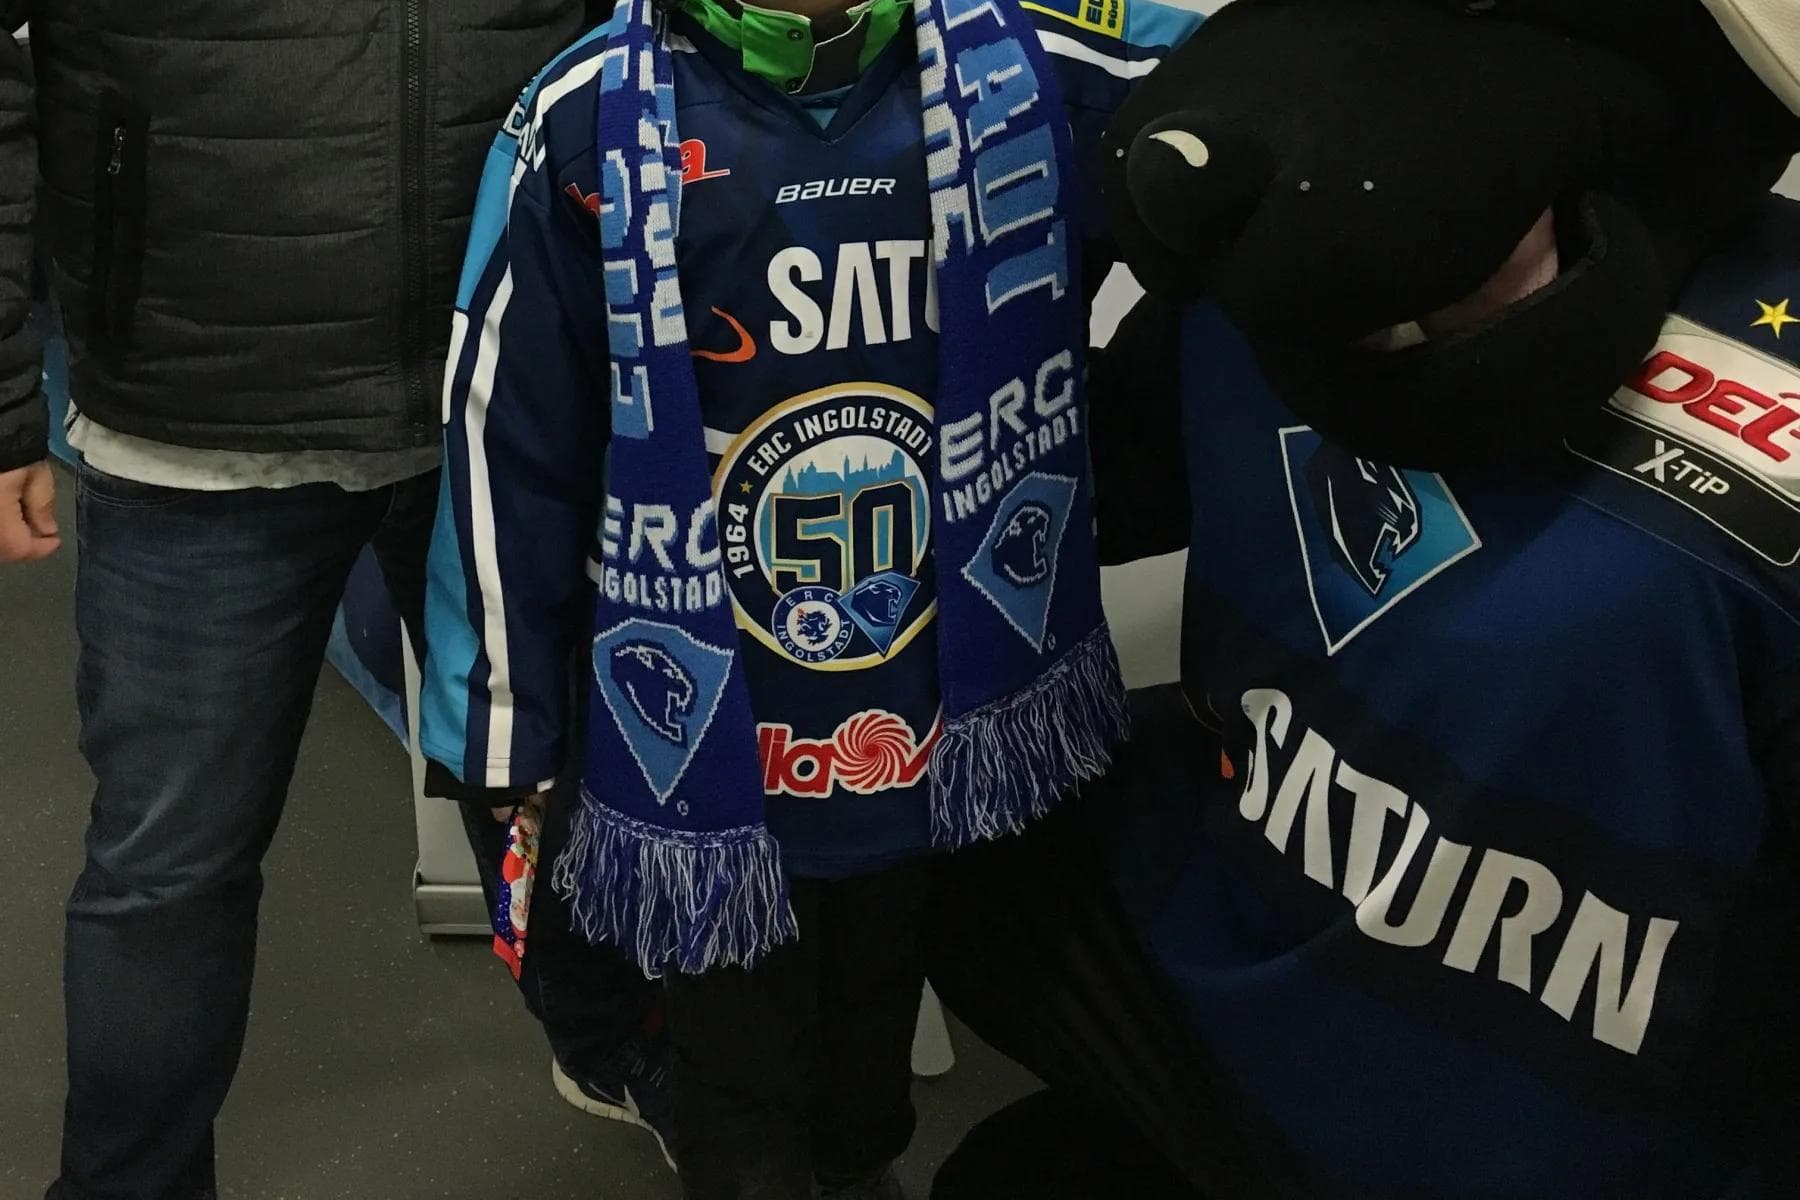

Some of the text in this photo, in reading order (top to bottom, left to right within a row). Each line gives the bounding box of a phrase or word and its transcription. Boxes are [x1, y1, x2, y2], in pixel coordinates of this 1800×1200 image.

[767, 239, 940, 356] SAT
[940, 349, 1074, 482] ERC
[943, 406, 1079, 523] INGOLSTADT
[1630, 350, 1800, 463] DEL
[726, 503, 754, 579] 1964
[747, 431, 792, 476] ERC
[771, 479, 918, 598] 50
[600, 562, 730, 613] GOLSTAD
[776, 619, 850, 662] INGOLSTADT
[785, 590, 834, 607] ERC
[1239, 688, 1680, 1056] SATURN
